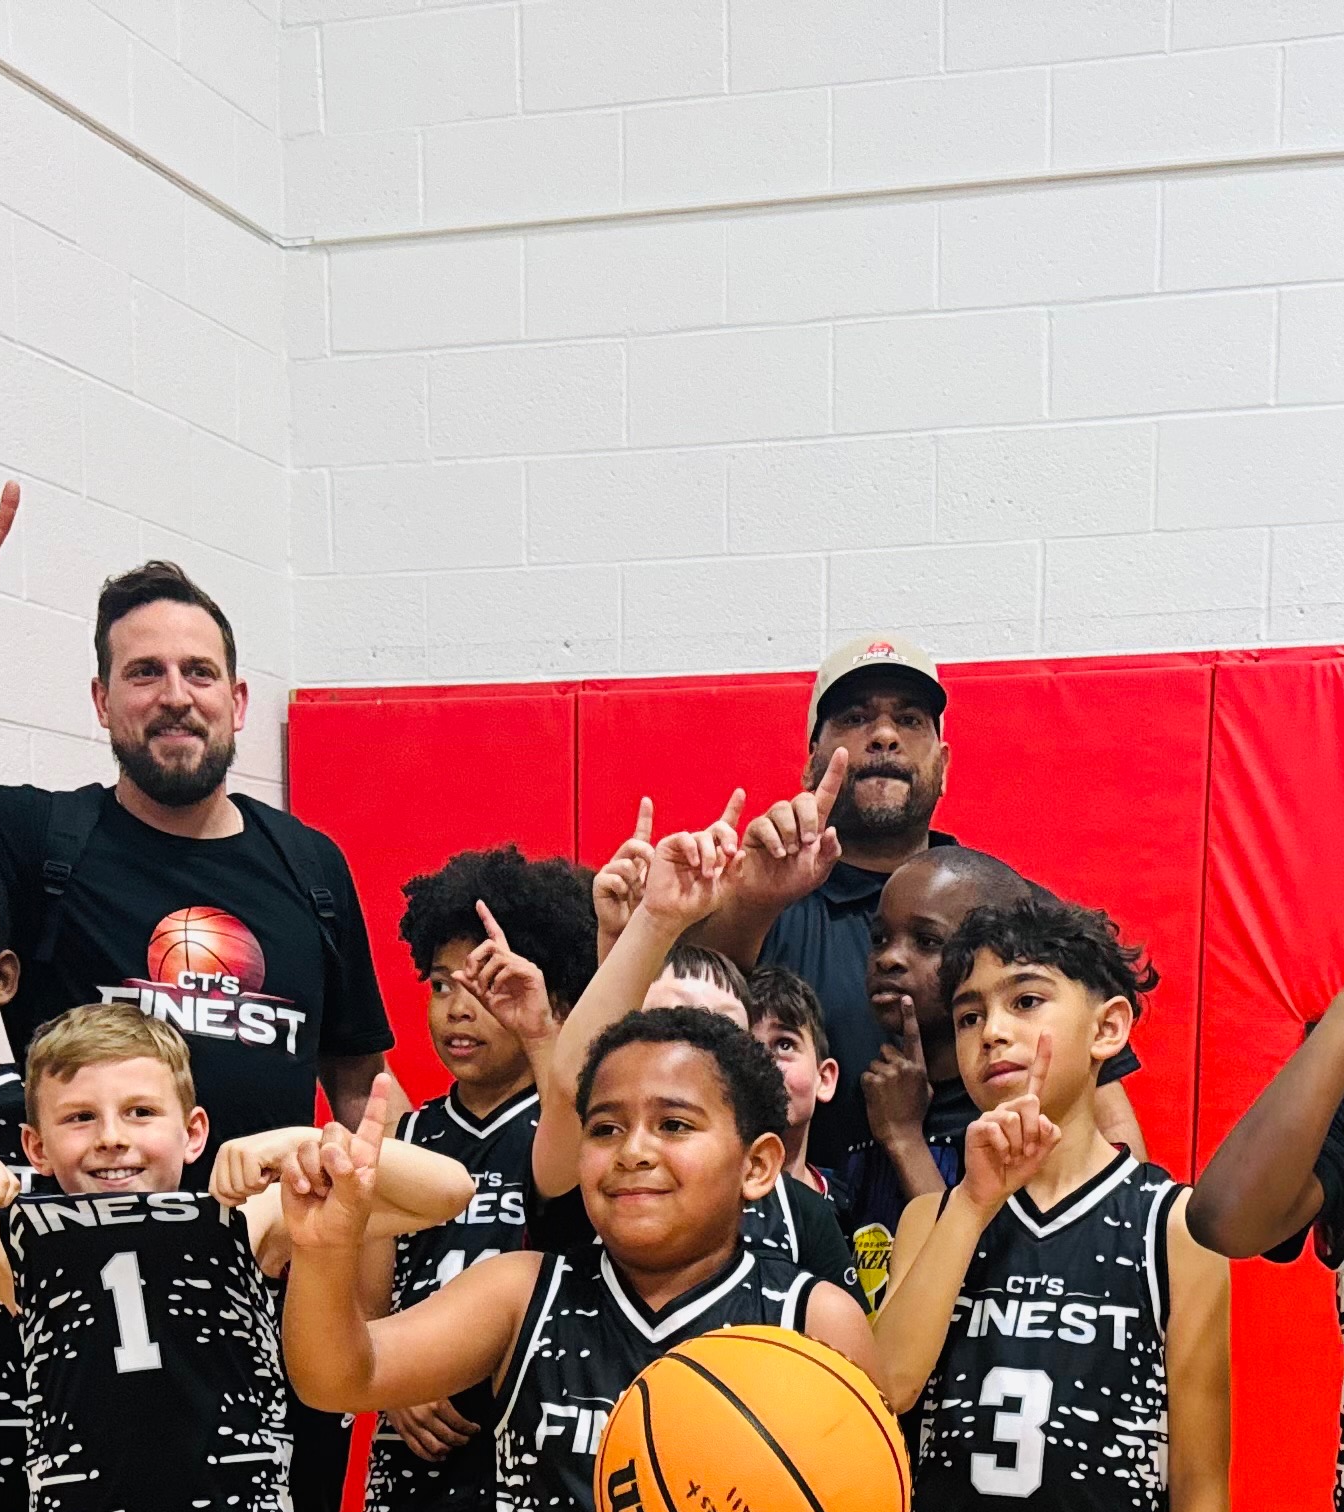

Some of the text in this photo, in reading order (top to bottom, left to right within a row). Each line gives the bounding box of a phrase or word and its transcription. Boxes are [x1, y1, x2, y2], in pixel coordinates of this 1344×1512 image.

[178, 971, 240, 995] CT'S
[96, 985, 306, 1055] FINEST
[470, 1170, 503, 1188] T'S
[1006, 1275, 1065, 1296] CT'S
[100, 1250, 163, 1374] 1
[970, 1366, 1054, 1499] 3
